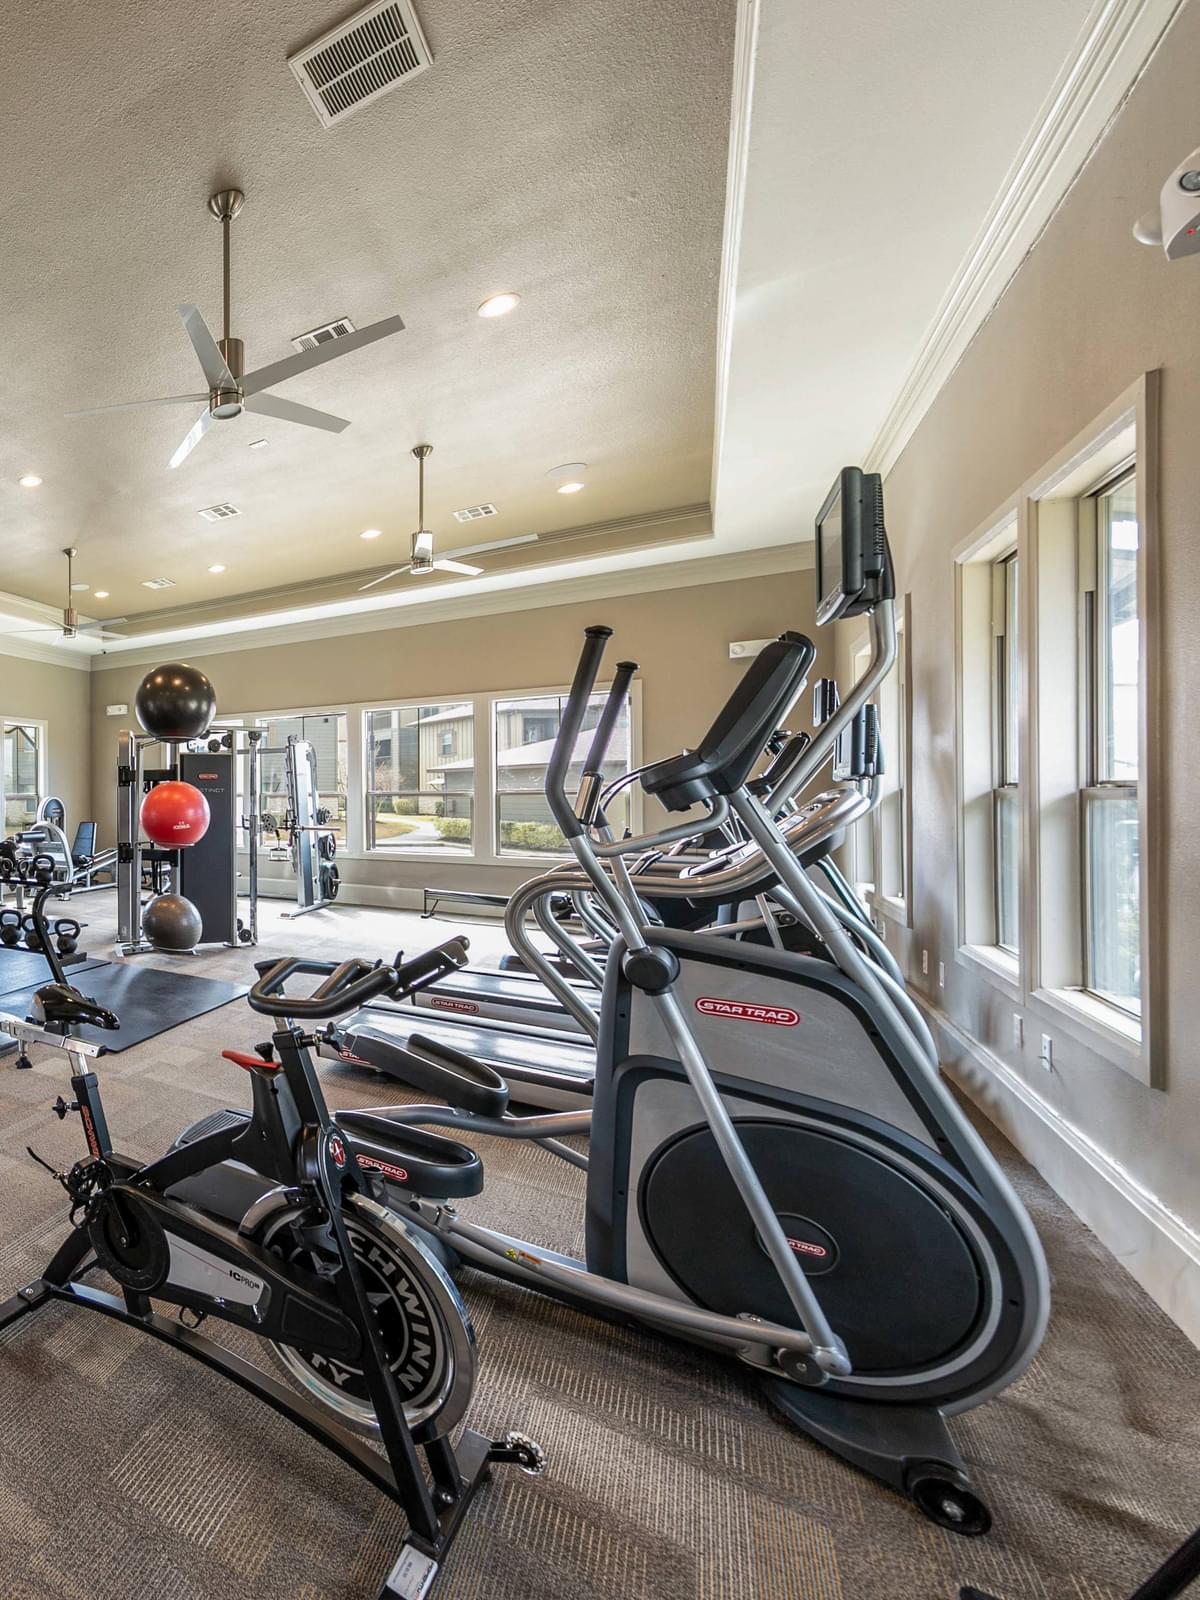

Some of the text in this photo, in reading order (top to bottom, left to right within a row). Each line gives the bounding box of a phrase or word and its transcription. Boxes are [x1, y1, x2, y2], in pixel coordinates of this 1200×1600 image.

[435, 1000, 475, 1011] STAR TRAC
[701, 1002, 790, 1021] STAR TRAC
[342, 1051, 360, 1059] STA
[358, 1157, 403, 1176] STAR TRAC
[797, 1243, 822, 1253] TRAC
[347, 1230, 432, 1392] CHWINN
